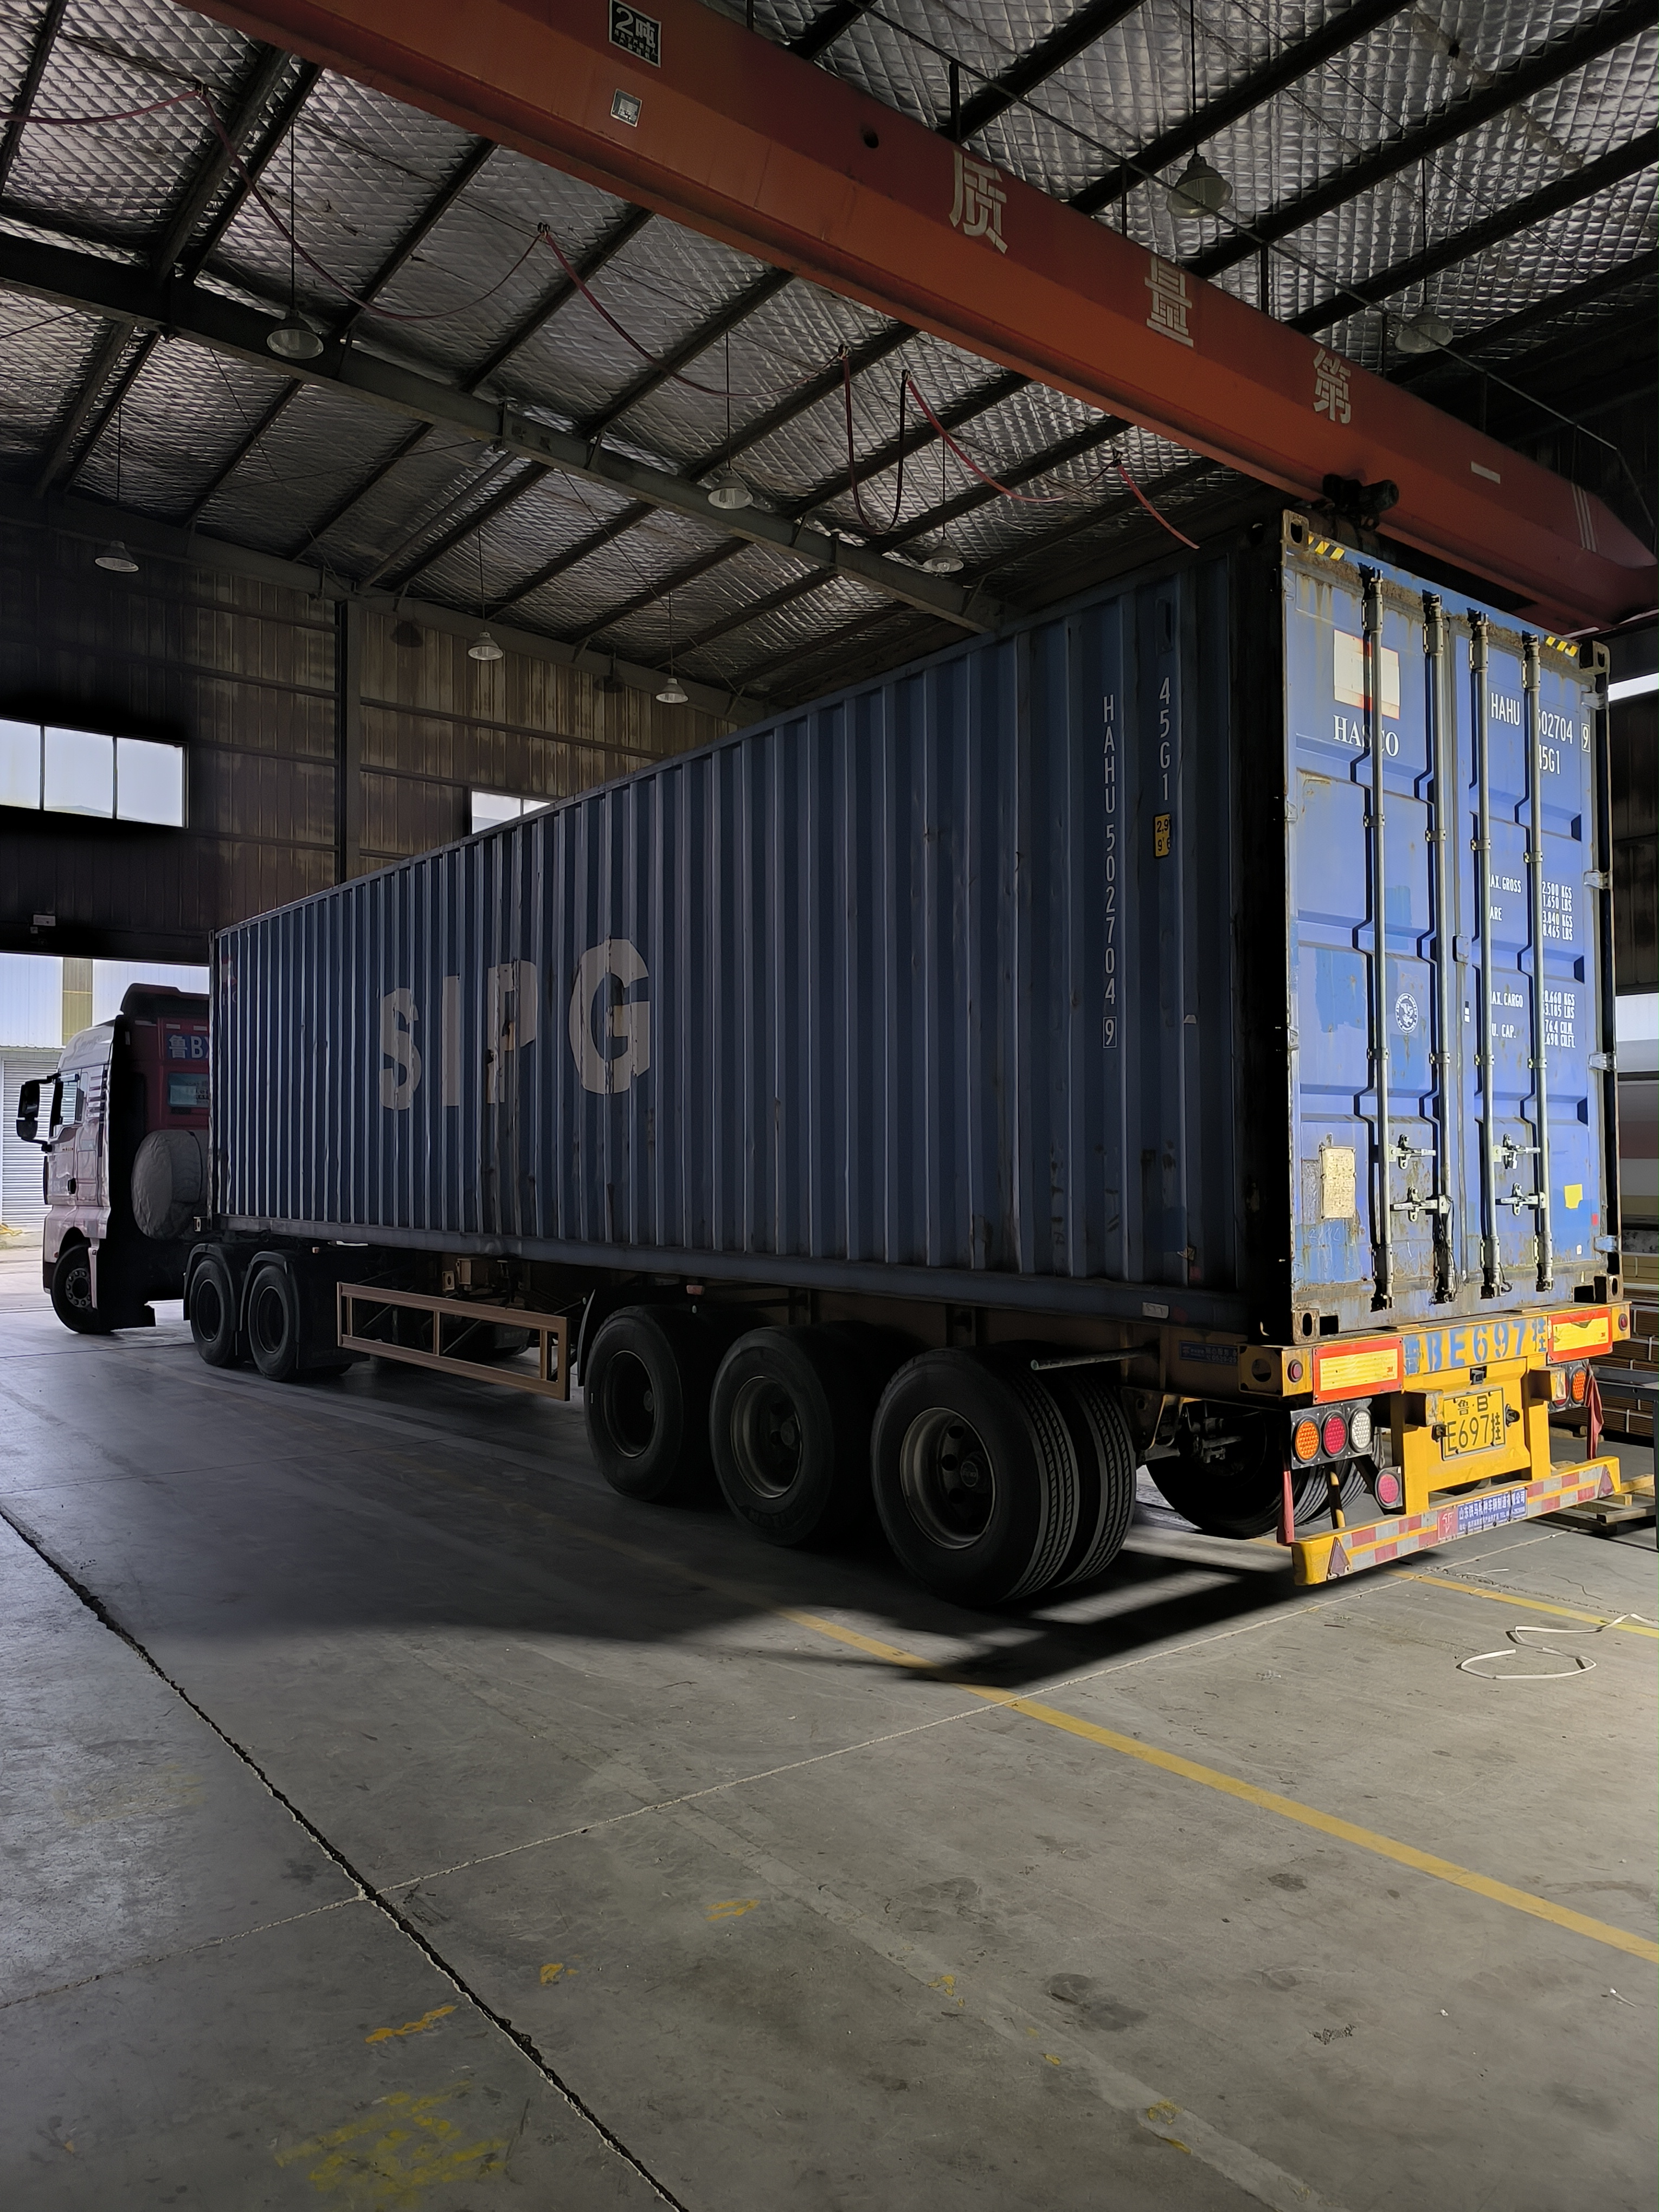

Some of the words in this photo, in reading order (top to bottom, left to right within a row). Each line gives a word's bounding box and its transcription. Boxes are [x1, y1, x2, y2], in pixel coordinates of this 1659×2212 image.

[615, 7, 656, 49] 2吨
[1333, 715, 1399, 757] HASO
[1491, 692, 1520, 725] HAHU
[1582, 725, 1590, 750] 9
[1103, 695, 1116, 815] HAHU
[1158, 677, 1171, 802] 45G1
[1489, 874, 1501, 890] AX.
[1502, 878, 1522, 893] GROSS
[1542, 881, 1559, 896] 2.500
[1561, 885, 1573, 899] KGS
[1490, 906, 1502, 921] ARE
[1561, 914, 1573, 928] KGS
[1542, 894, 1559, 909] 1.650
[1561, 898, 1572, 912] LBS
[1562, 927, 1573, 941] LBS
[1490, 991, 1503, 1006] AX.
[1503, 992, 1523, 1008] CARGO
[1543, 989, 1561, 1004] 8.660
[1564, 993, 1575, 1006] KGS
[1564, 1006, 1575, 1019] LBS
[379, 938, 651, 1110] SIPG
[1501, 1024, 1516, 1038] CAP.
[1446, 1412, 1501, 1452] E697挂
